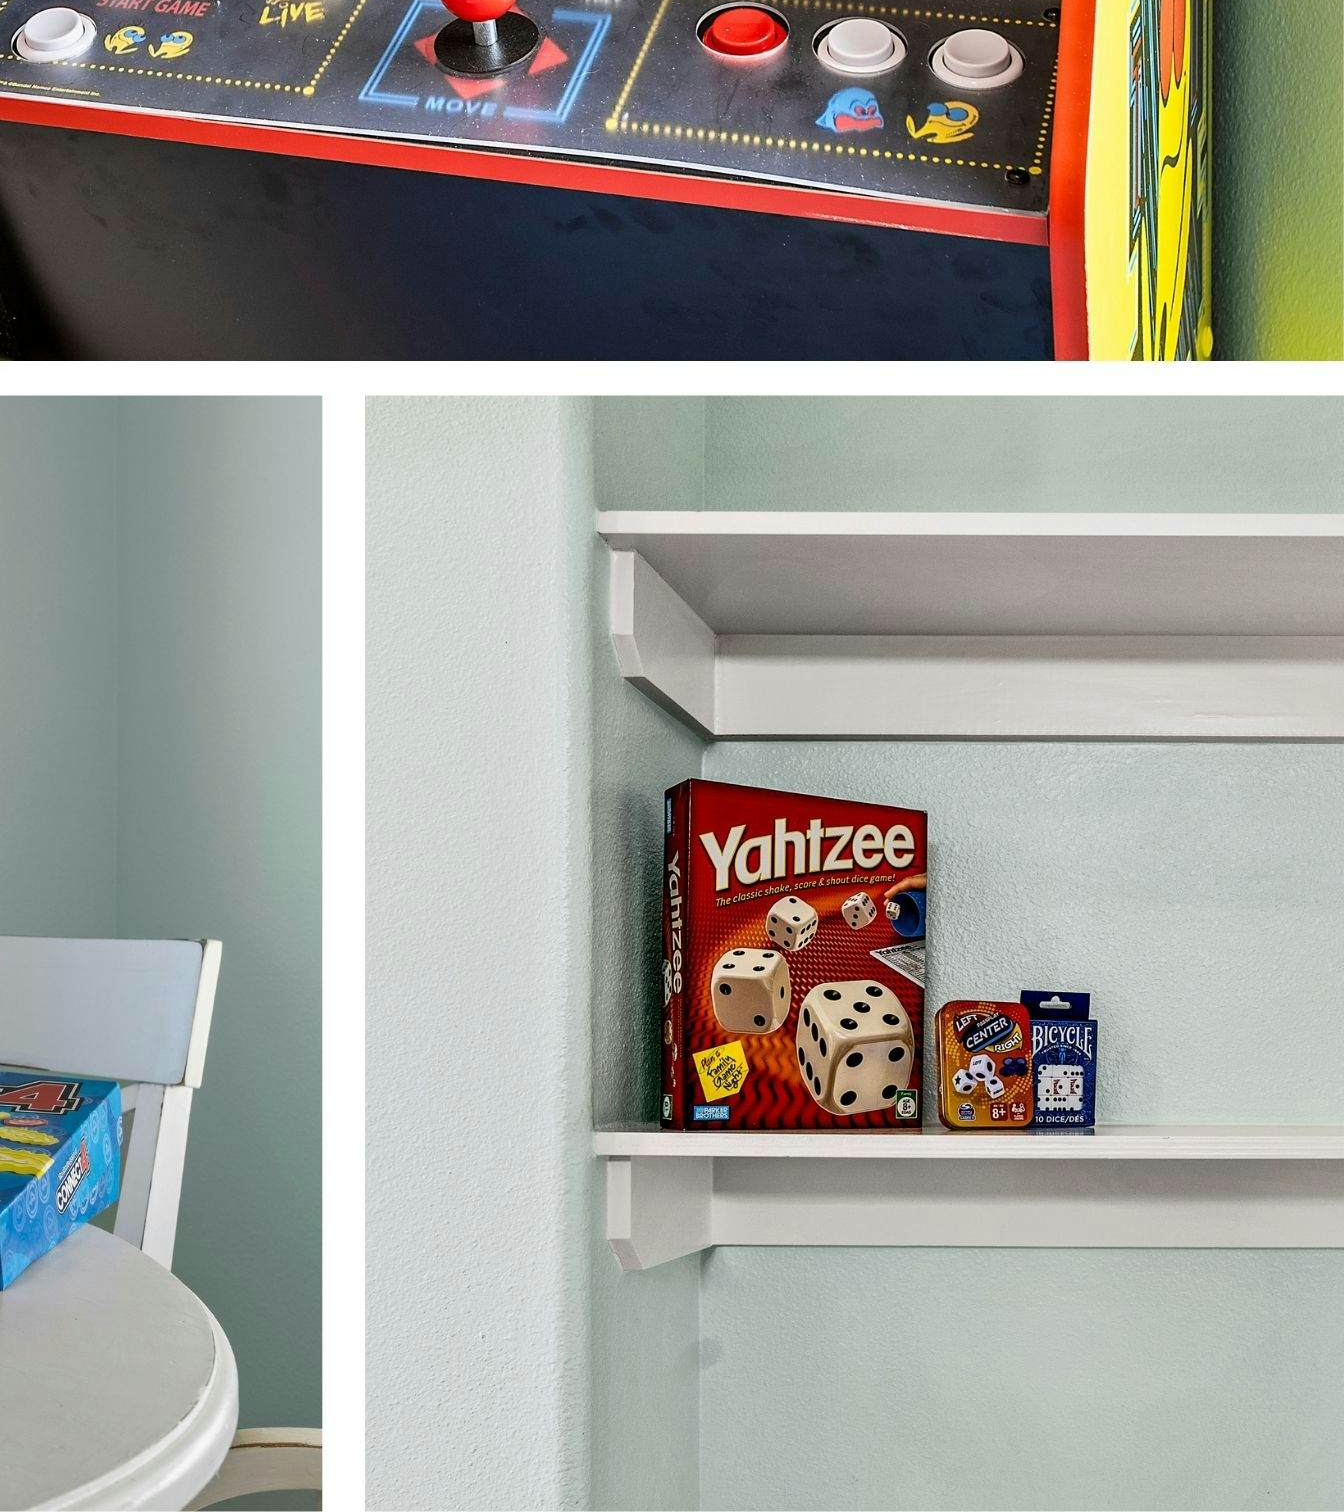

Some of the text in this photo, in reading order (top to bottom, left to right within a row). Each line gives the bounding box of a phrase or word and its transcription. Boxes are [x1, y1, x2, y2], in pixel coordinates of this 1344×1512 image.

[425, 96, 499, 117] MOVE
[699, 817, 916, 891] Yahtzee
[716, 873, 896, 908] The classic shake, score & shout dice game!
[668, 849, 683, 994] Yahtzee
[956, 1014, 978, 1032] LEFT
[966, 1017, 1009, 1048] CENTER
[994, 1032, 1022, 1052] RIGHT
[1031, 1025, 1092, 1061] BICYCLE
[707, 1055, 736, 1078] Family
[713, 1064, 736, 1091] Game
[992, 1108, 1006, 1119] 8+
